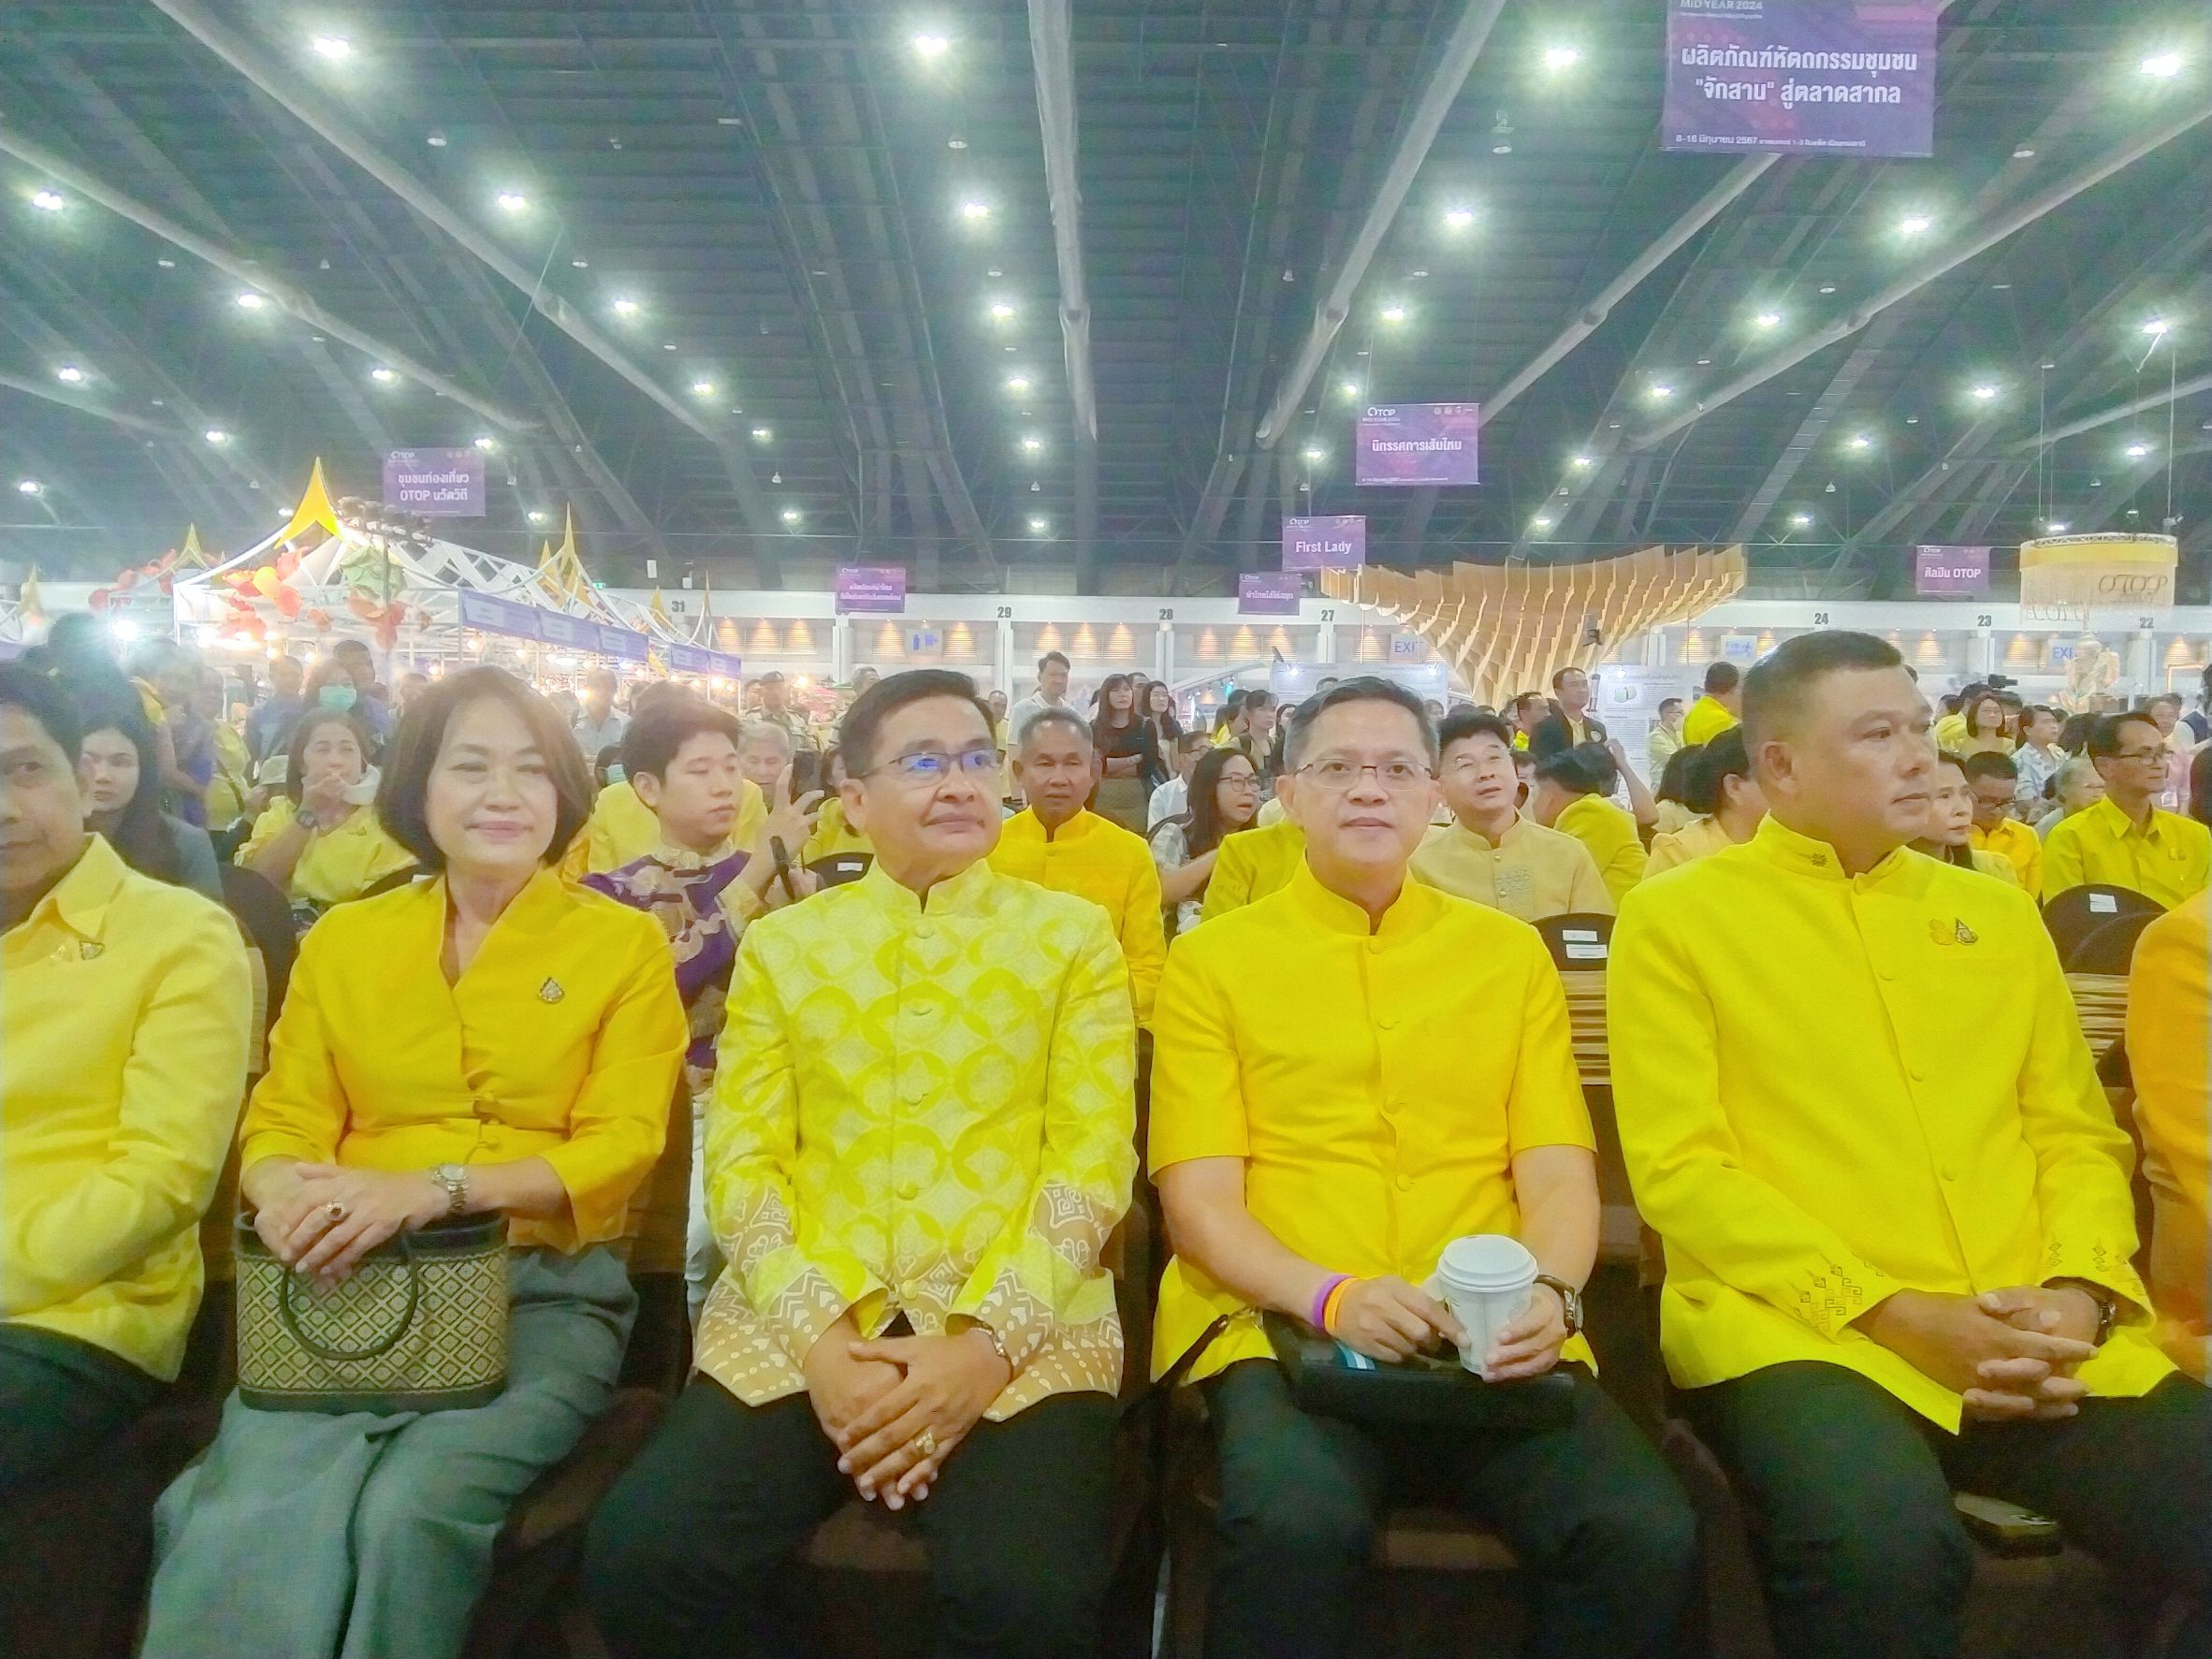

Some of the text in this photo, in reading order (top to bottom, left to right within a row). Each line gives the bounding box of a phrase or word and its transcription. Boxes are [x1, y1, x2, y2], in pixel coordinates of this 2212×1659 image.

[1706, 0, 1734, 9] YEAR
[1736, 0, 1763, 10] 2024
[1681, 44, 1917, 78] ผลิตภัณฑ์หัตถกรรมชุมชน
[1695, 76, 1900, 109] "จักสาน" สู่ตลาดสากล
[398, 468, 469, 488] ชุมชนท่องเที่ยว
[400, 489, 430, 502] OTOP
[1295, 541, 1352, 555] First Lady
[1924, 566, 1981, 578] ศิลปิน OTOP
[997, 605, 1011, 618] 29
[1159, 608, 1173, 620] 28
[1320, 609, 1334, 622] 27
[1814, 612, 1829, 624] 24
[1977, 615, 1992, 627] 23
[2139, 617, 2154, 629] 22
